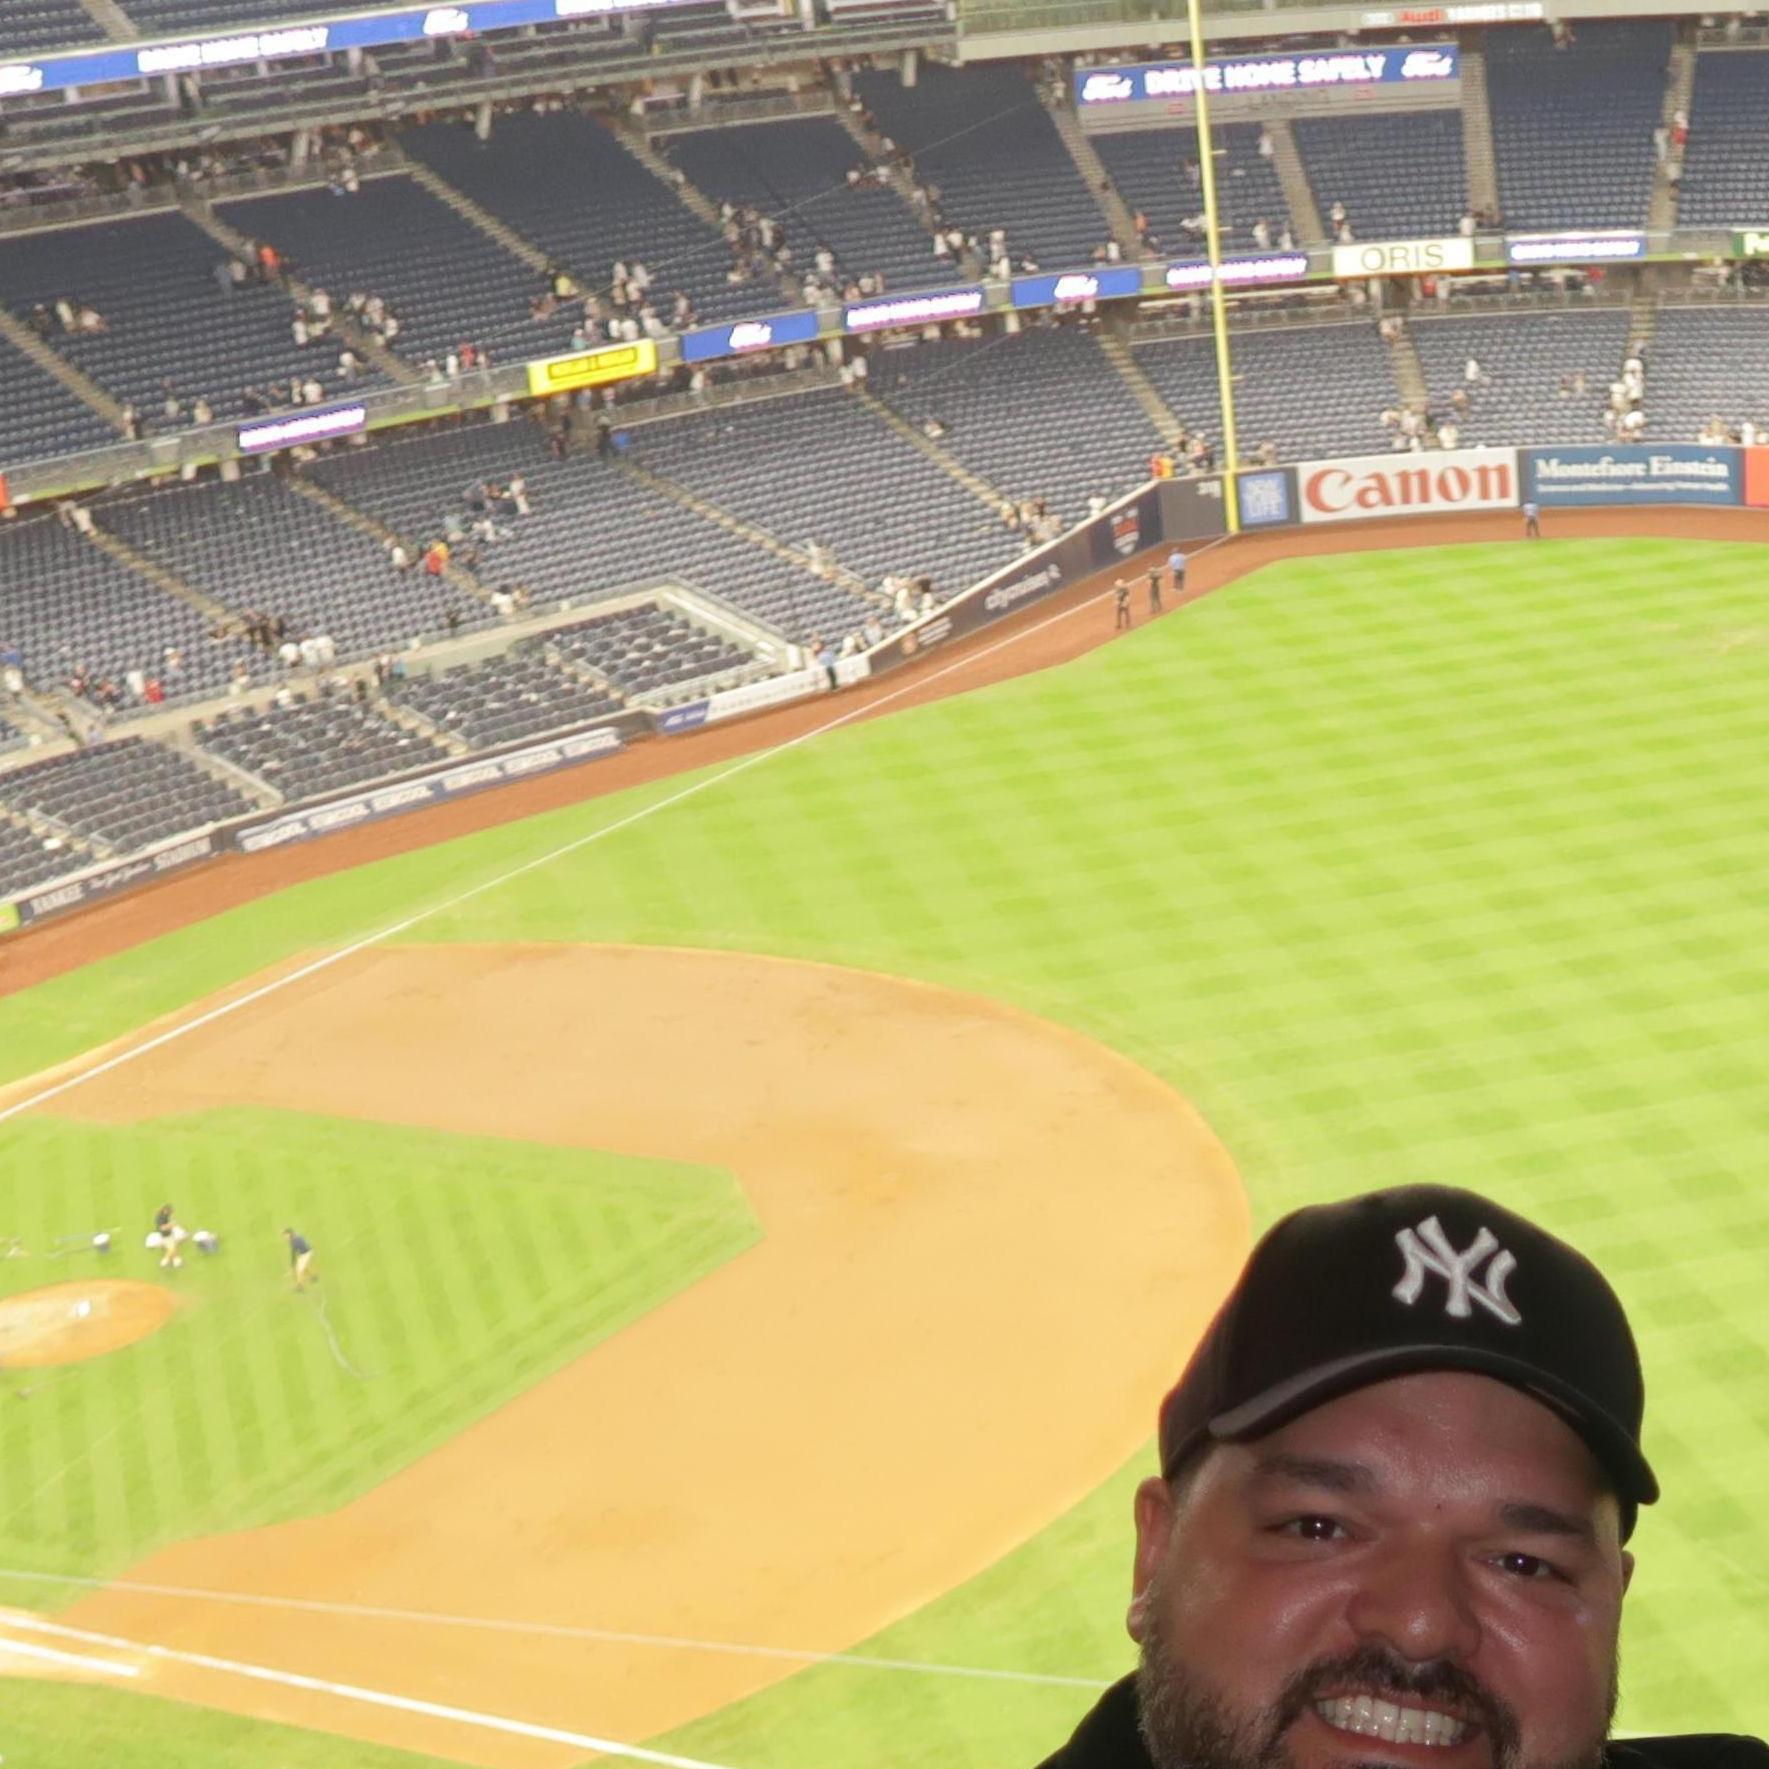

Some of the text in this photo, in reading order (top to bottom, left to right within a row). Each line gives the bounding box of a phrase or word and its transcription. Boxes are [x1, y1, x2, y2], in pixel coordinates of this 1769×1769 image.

[1360, 243, 1444, 271] ORIS
[1304, 462, 1511, 514] Canon
[1391, 1214, 1523, 1327] NY
